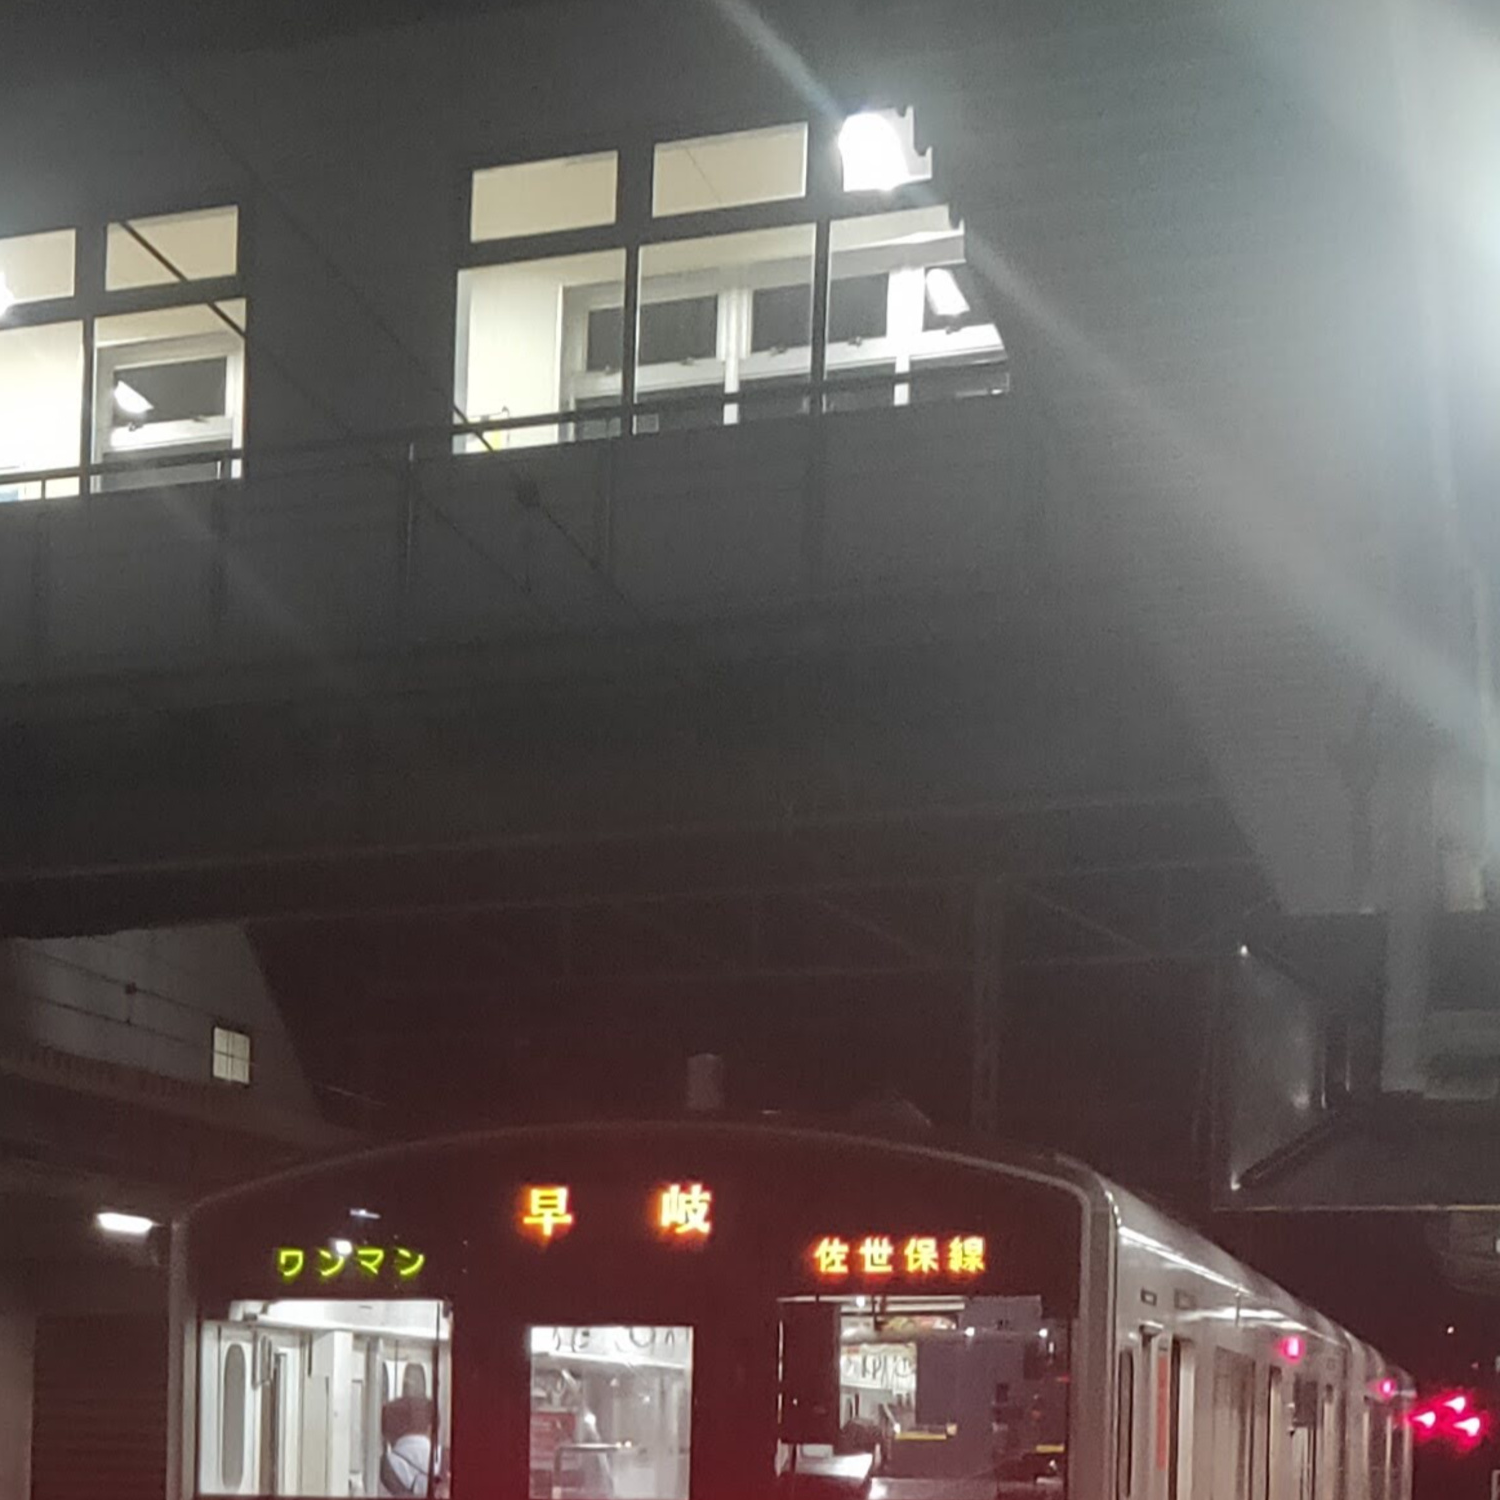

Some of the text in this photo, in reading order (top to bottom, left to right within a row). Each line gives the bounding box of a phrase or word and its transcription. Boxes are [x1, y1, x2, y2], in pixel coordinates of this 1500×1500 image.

[278, 1247, 424, 1276] ワンマン
[813, 1236, 986, 1274] 佐世保線
